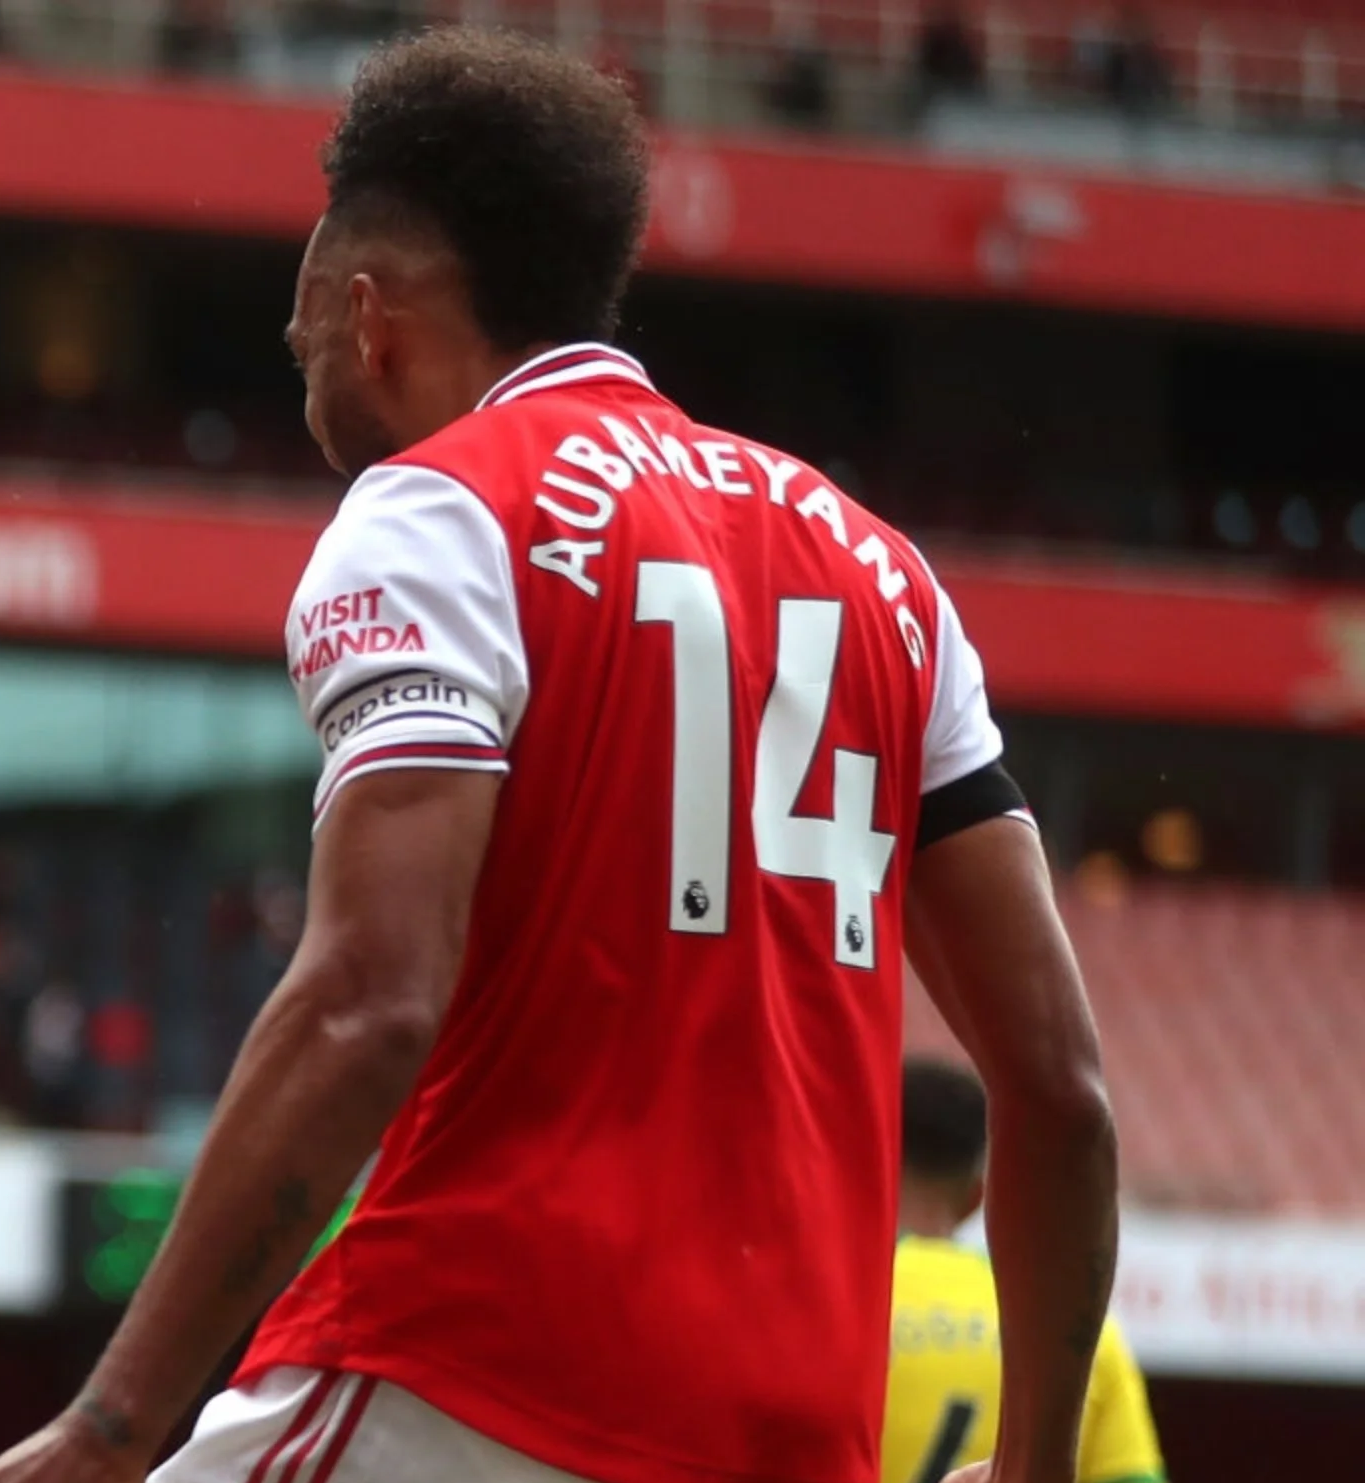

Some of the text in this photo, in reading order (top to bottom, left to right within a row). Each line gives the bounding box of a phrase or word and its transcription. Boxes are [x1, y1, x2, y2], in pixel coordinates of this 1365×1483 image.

[301, 587, 383, 638] VISIT
[292, 623, 426, 683] WANDA
[324, 677, 468, 752] Captain
[634, 560, 897, 972] 14
